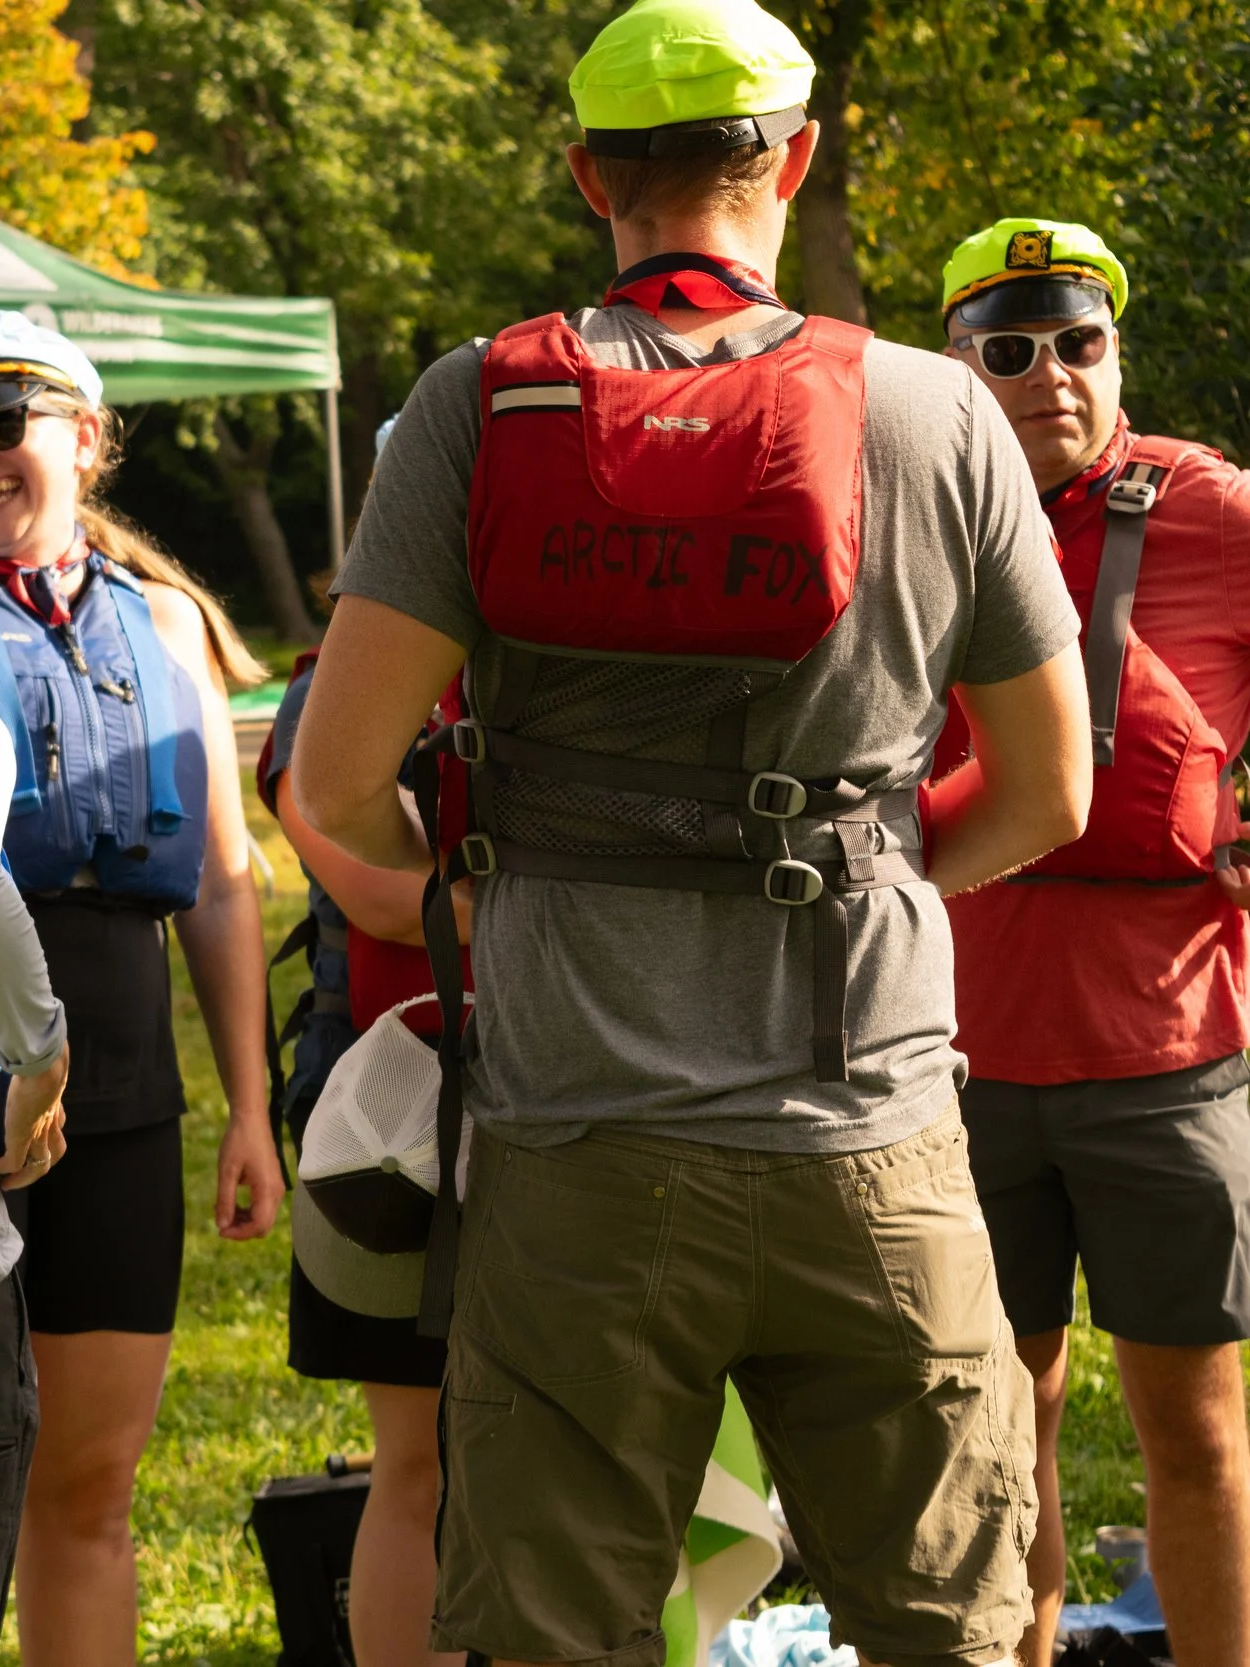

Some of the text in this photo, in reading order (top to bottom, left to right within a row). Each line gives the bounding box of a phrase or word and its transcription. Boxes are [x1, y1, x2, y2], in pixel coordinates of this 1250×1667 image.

[643, 415, 710, 433] NRS
[540, 518, 830, 605] ARCTIC FOX
